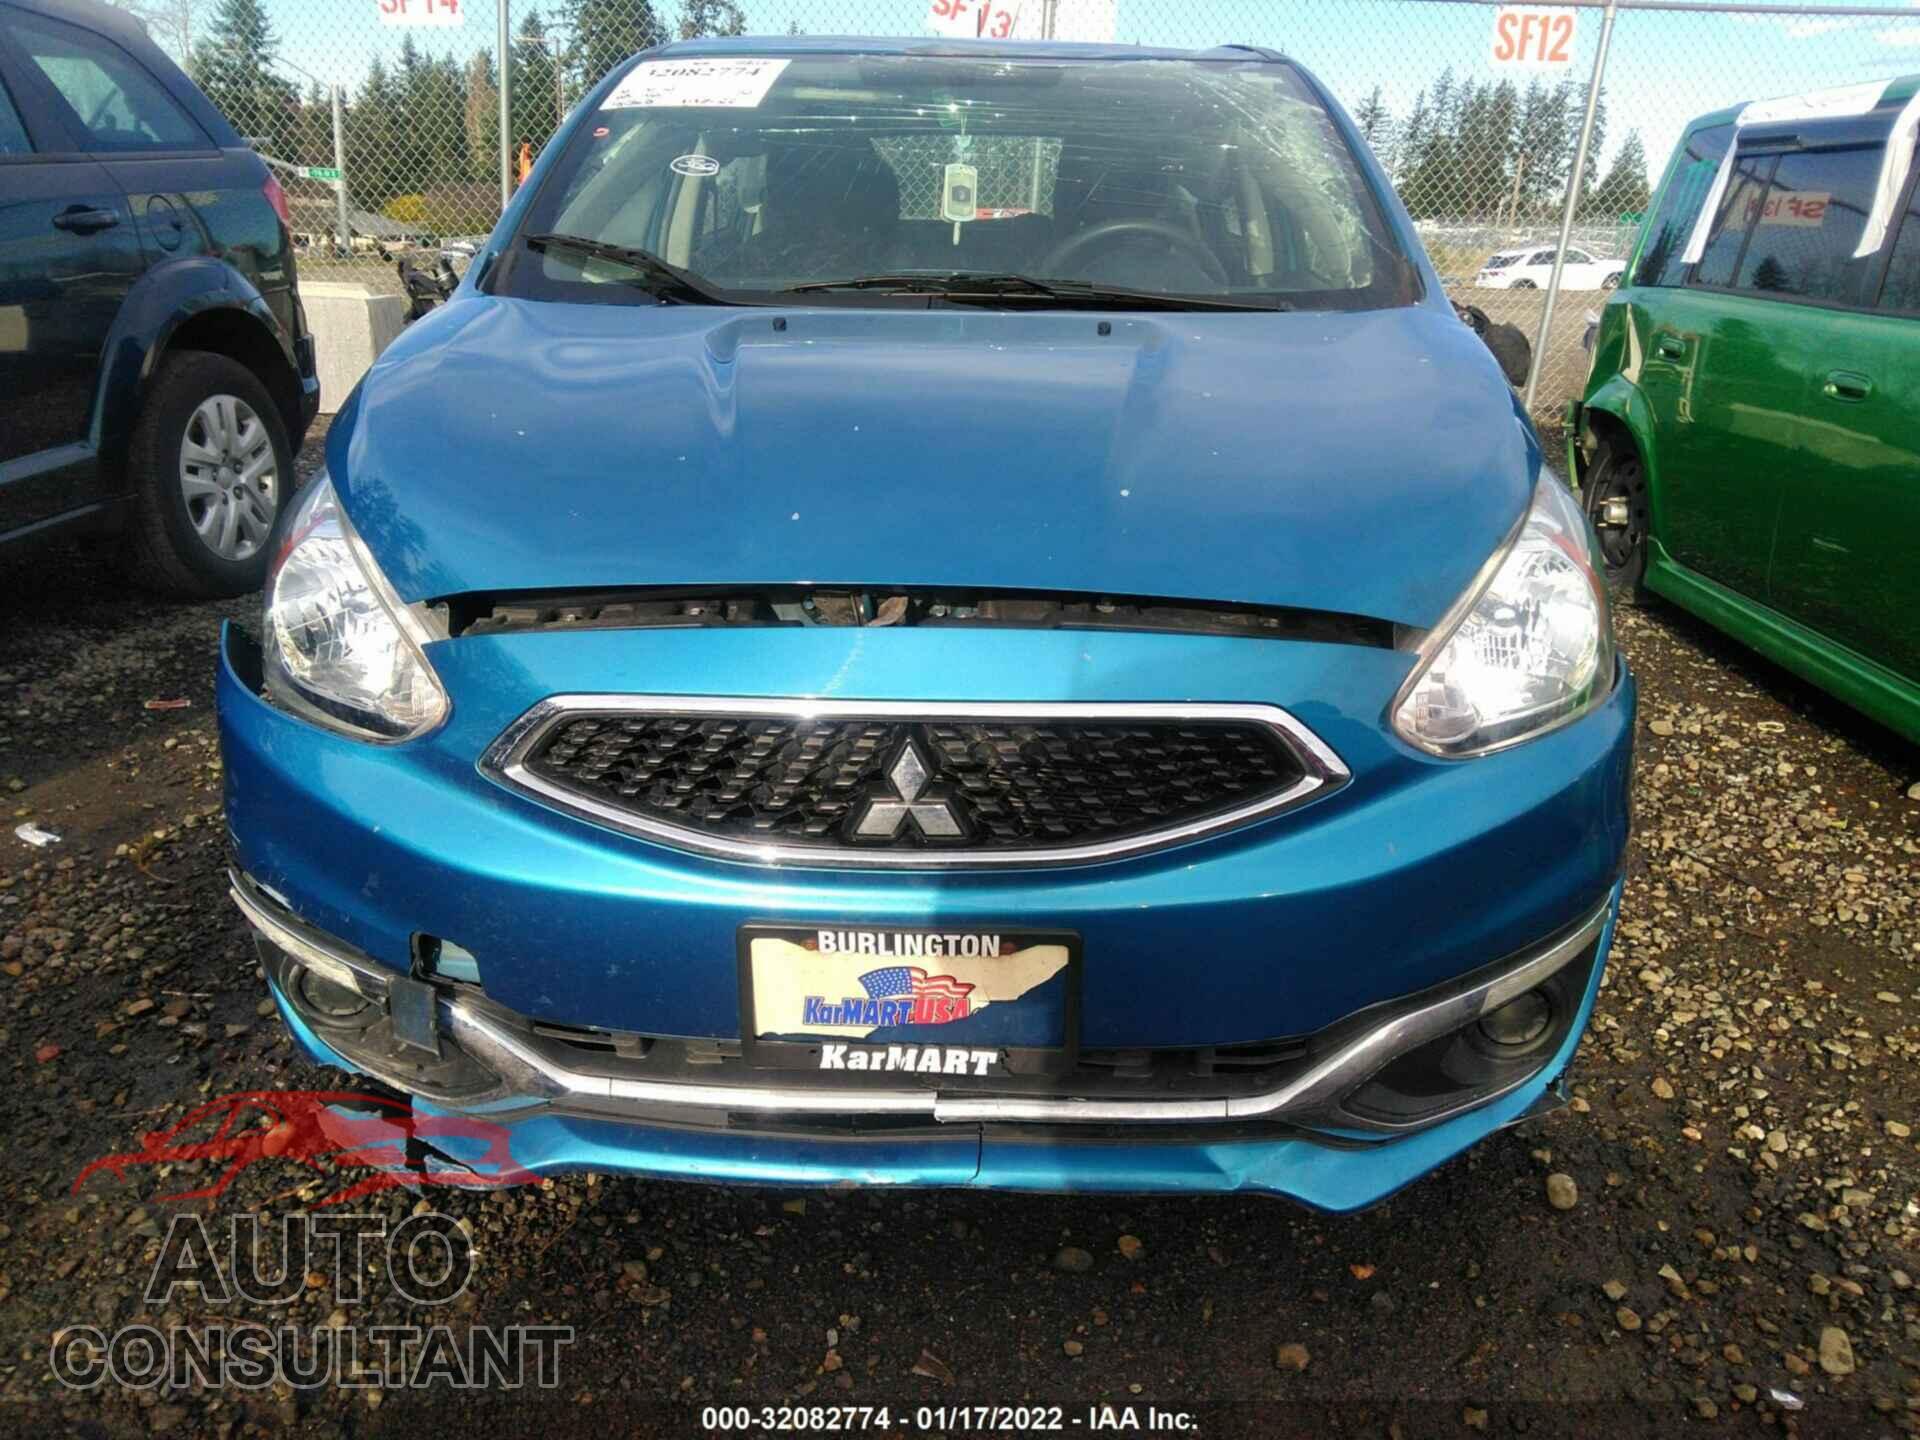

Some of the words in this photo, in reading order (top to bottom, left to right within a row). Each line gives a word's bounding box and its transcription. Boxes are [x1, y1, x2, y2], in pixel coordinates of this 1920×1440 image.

[1494, 13, 1574, 61] SF12
[817, 930, 1001, 958] BURLINGTON
[819, 1043, 999, 1077] KarMART
